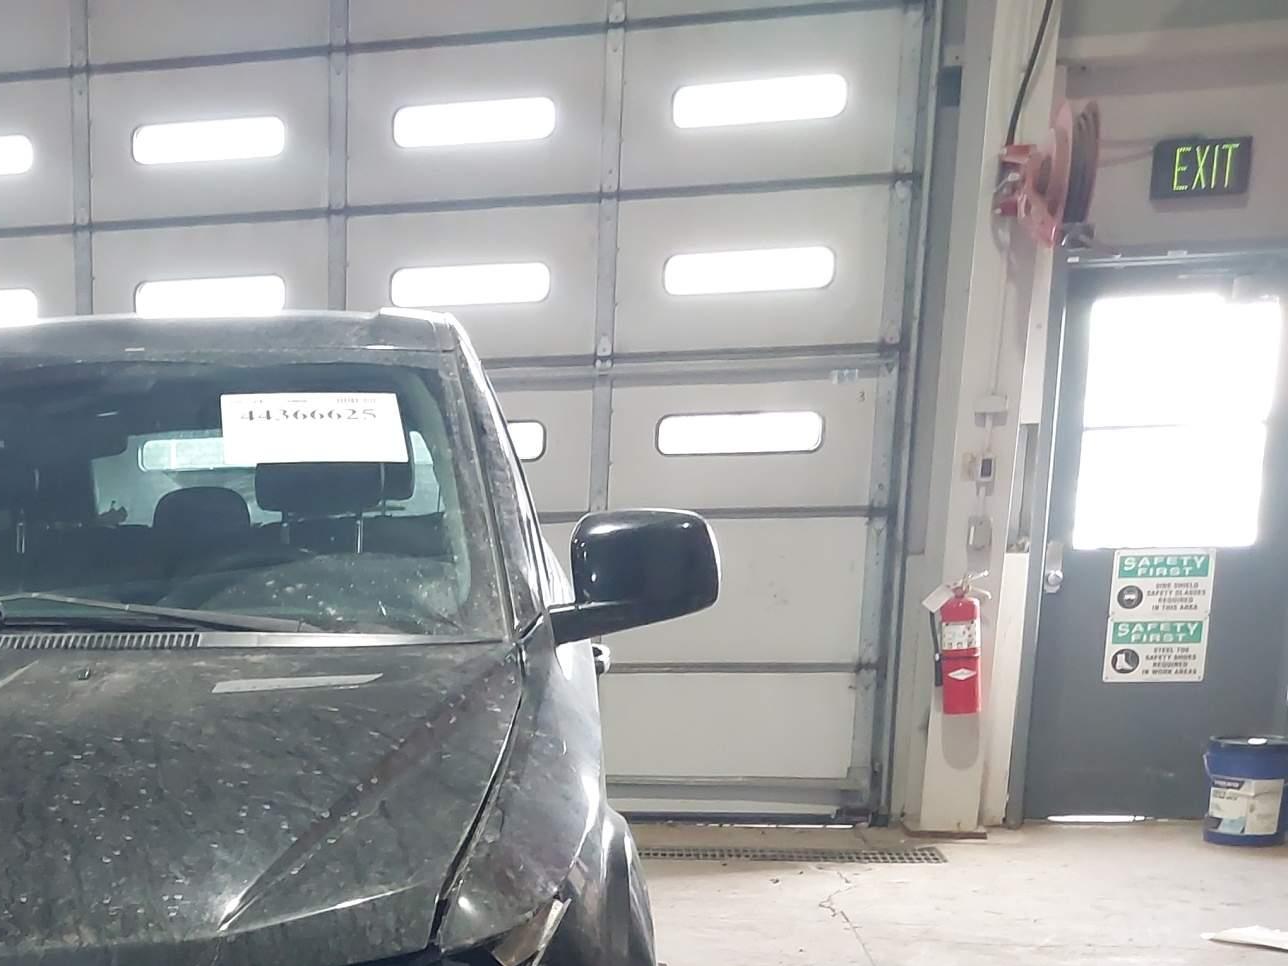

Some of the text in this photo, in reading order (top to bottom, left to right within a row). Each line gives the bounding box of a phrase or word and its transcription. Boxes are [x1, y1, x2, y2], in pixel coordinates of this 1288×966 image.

[1173, 143, 1240, 191] EXIT
[241, 408, 377, 421] 44366625
[1123, 556, 1205, 571] SAFETY
[1137, 566, 1192, 576] FIRST
[1118, 623, 1198, 637] SAFETY
[1131, 633, 1186, 643] FIRST
